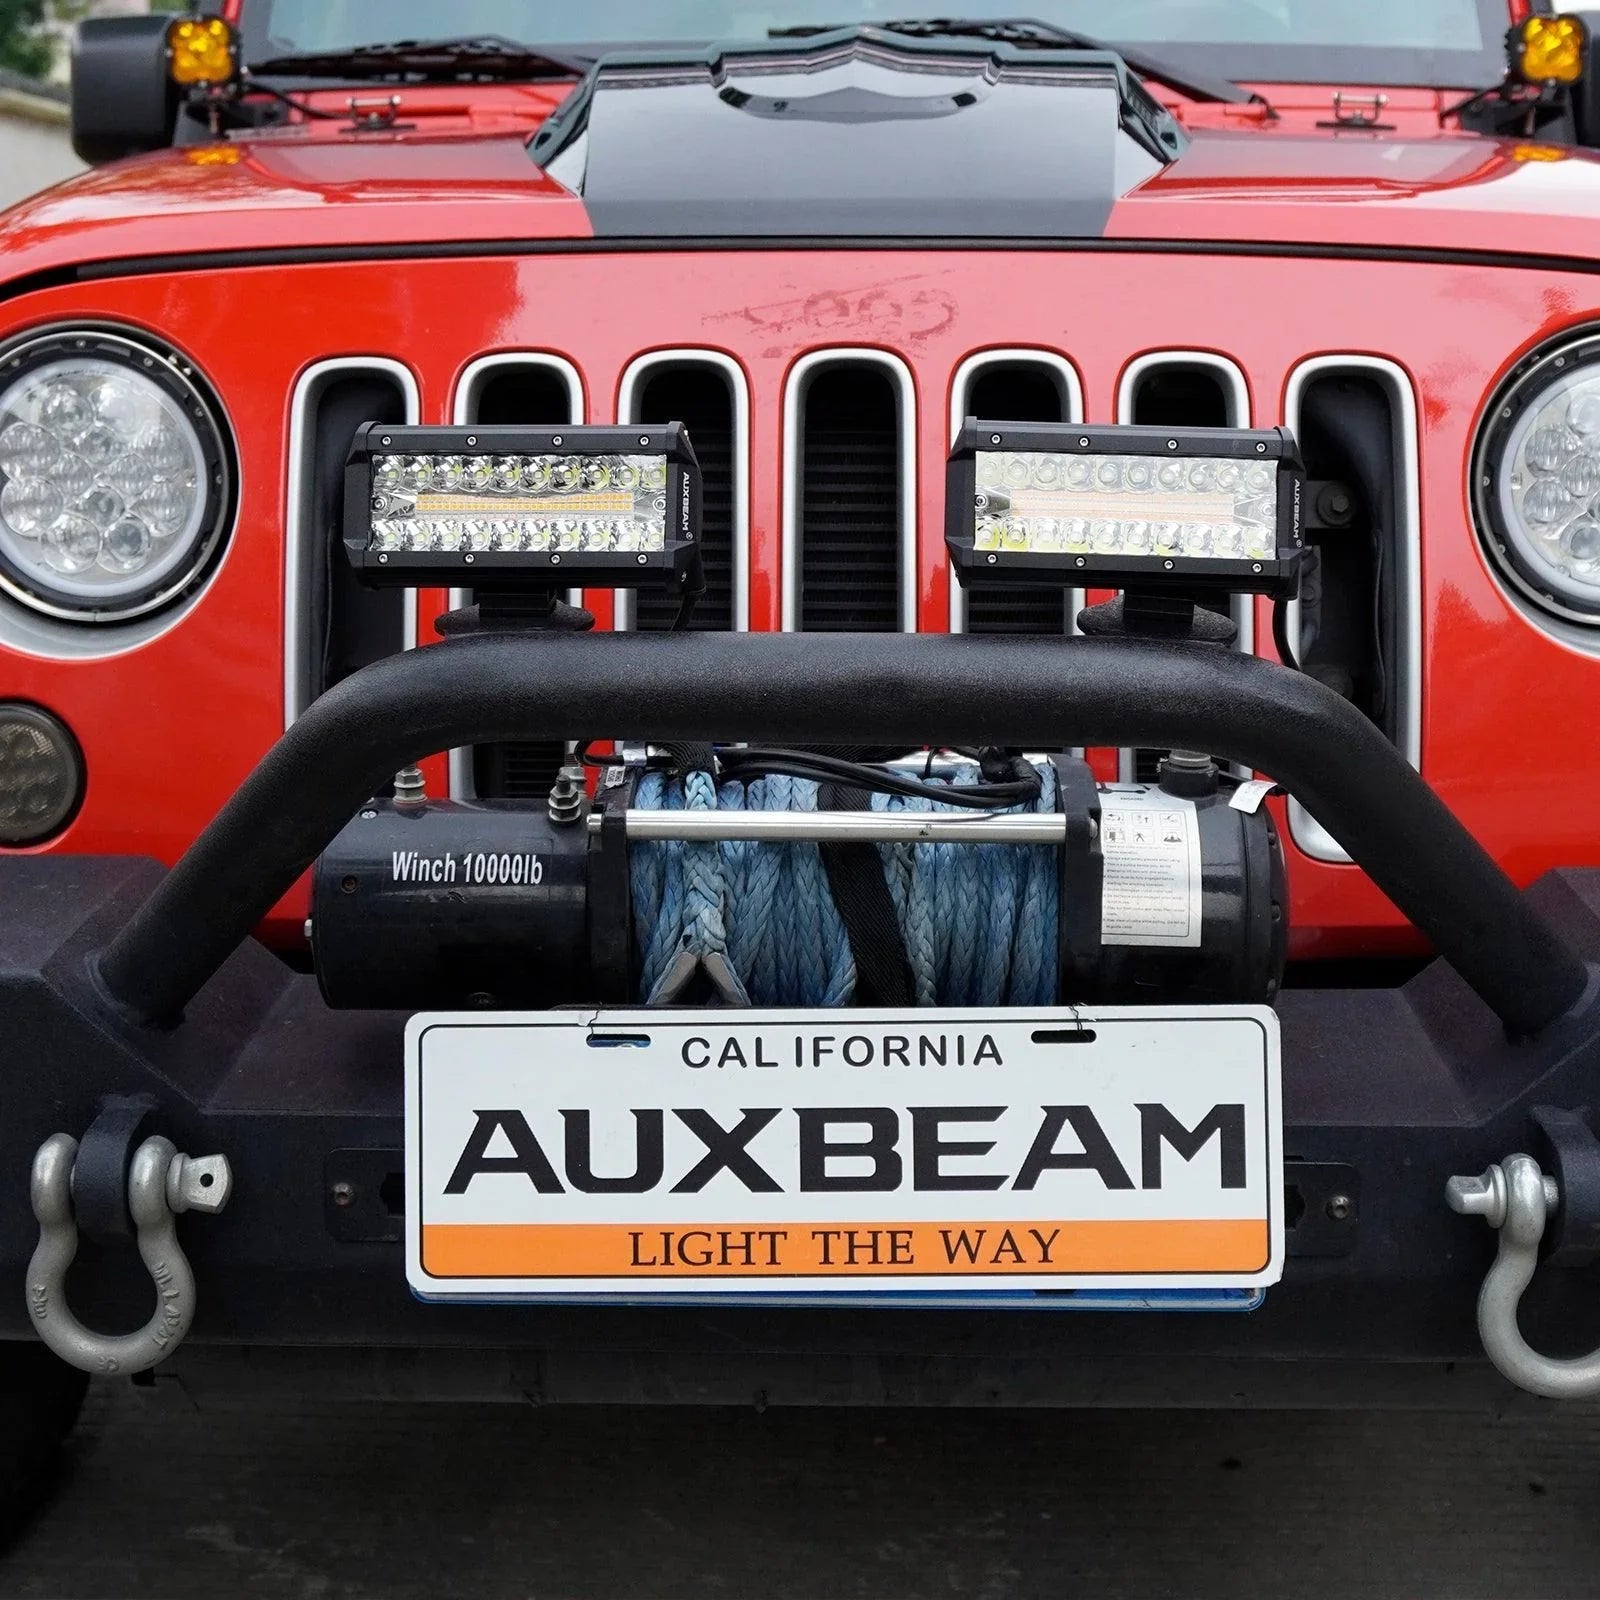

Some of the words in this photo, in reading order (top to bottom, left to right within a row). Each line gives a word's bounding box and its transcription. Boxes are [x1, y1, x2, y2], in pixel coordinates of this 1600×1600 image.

[392, 851, 457, 883] Winch
[463, 852, 543, 885] 10000lb
[681, 1034, 1004, 1070] CALIFORNIA
[442, 1103, 1248, 1195] AUXBEAM
[628, 1231, 788, 1267] LIGHT
[811, 1230, 914, 1266] THE
[938, 1228, 1062, 1265] WAY
